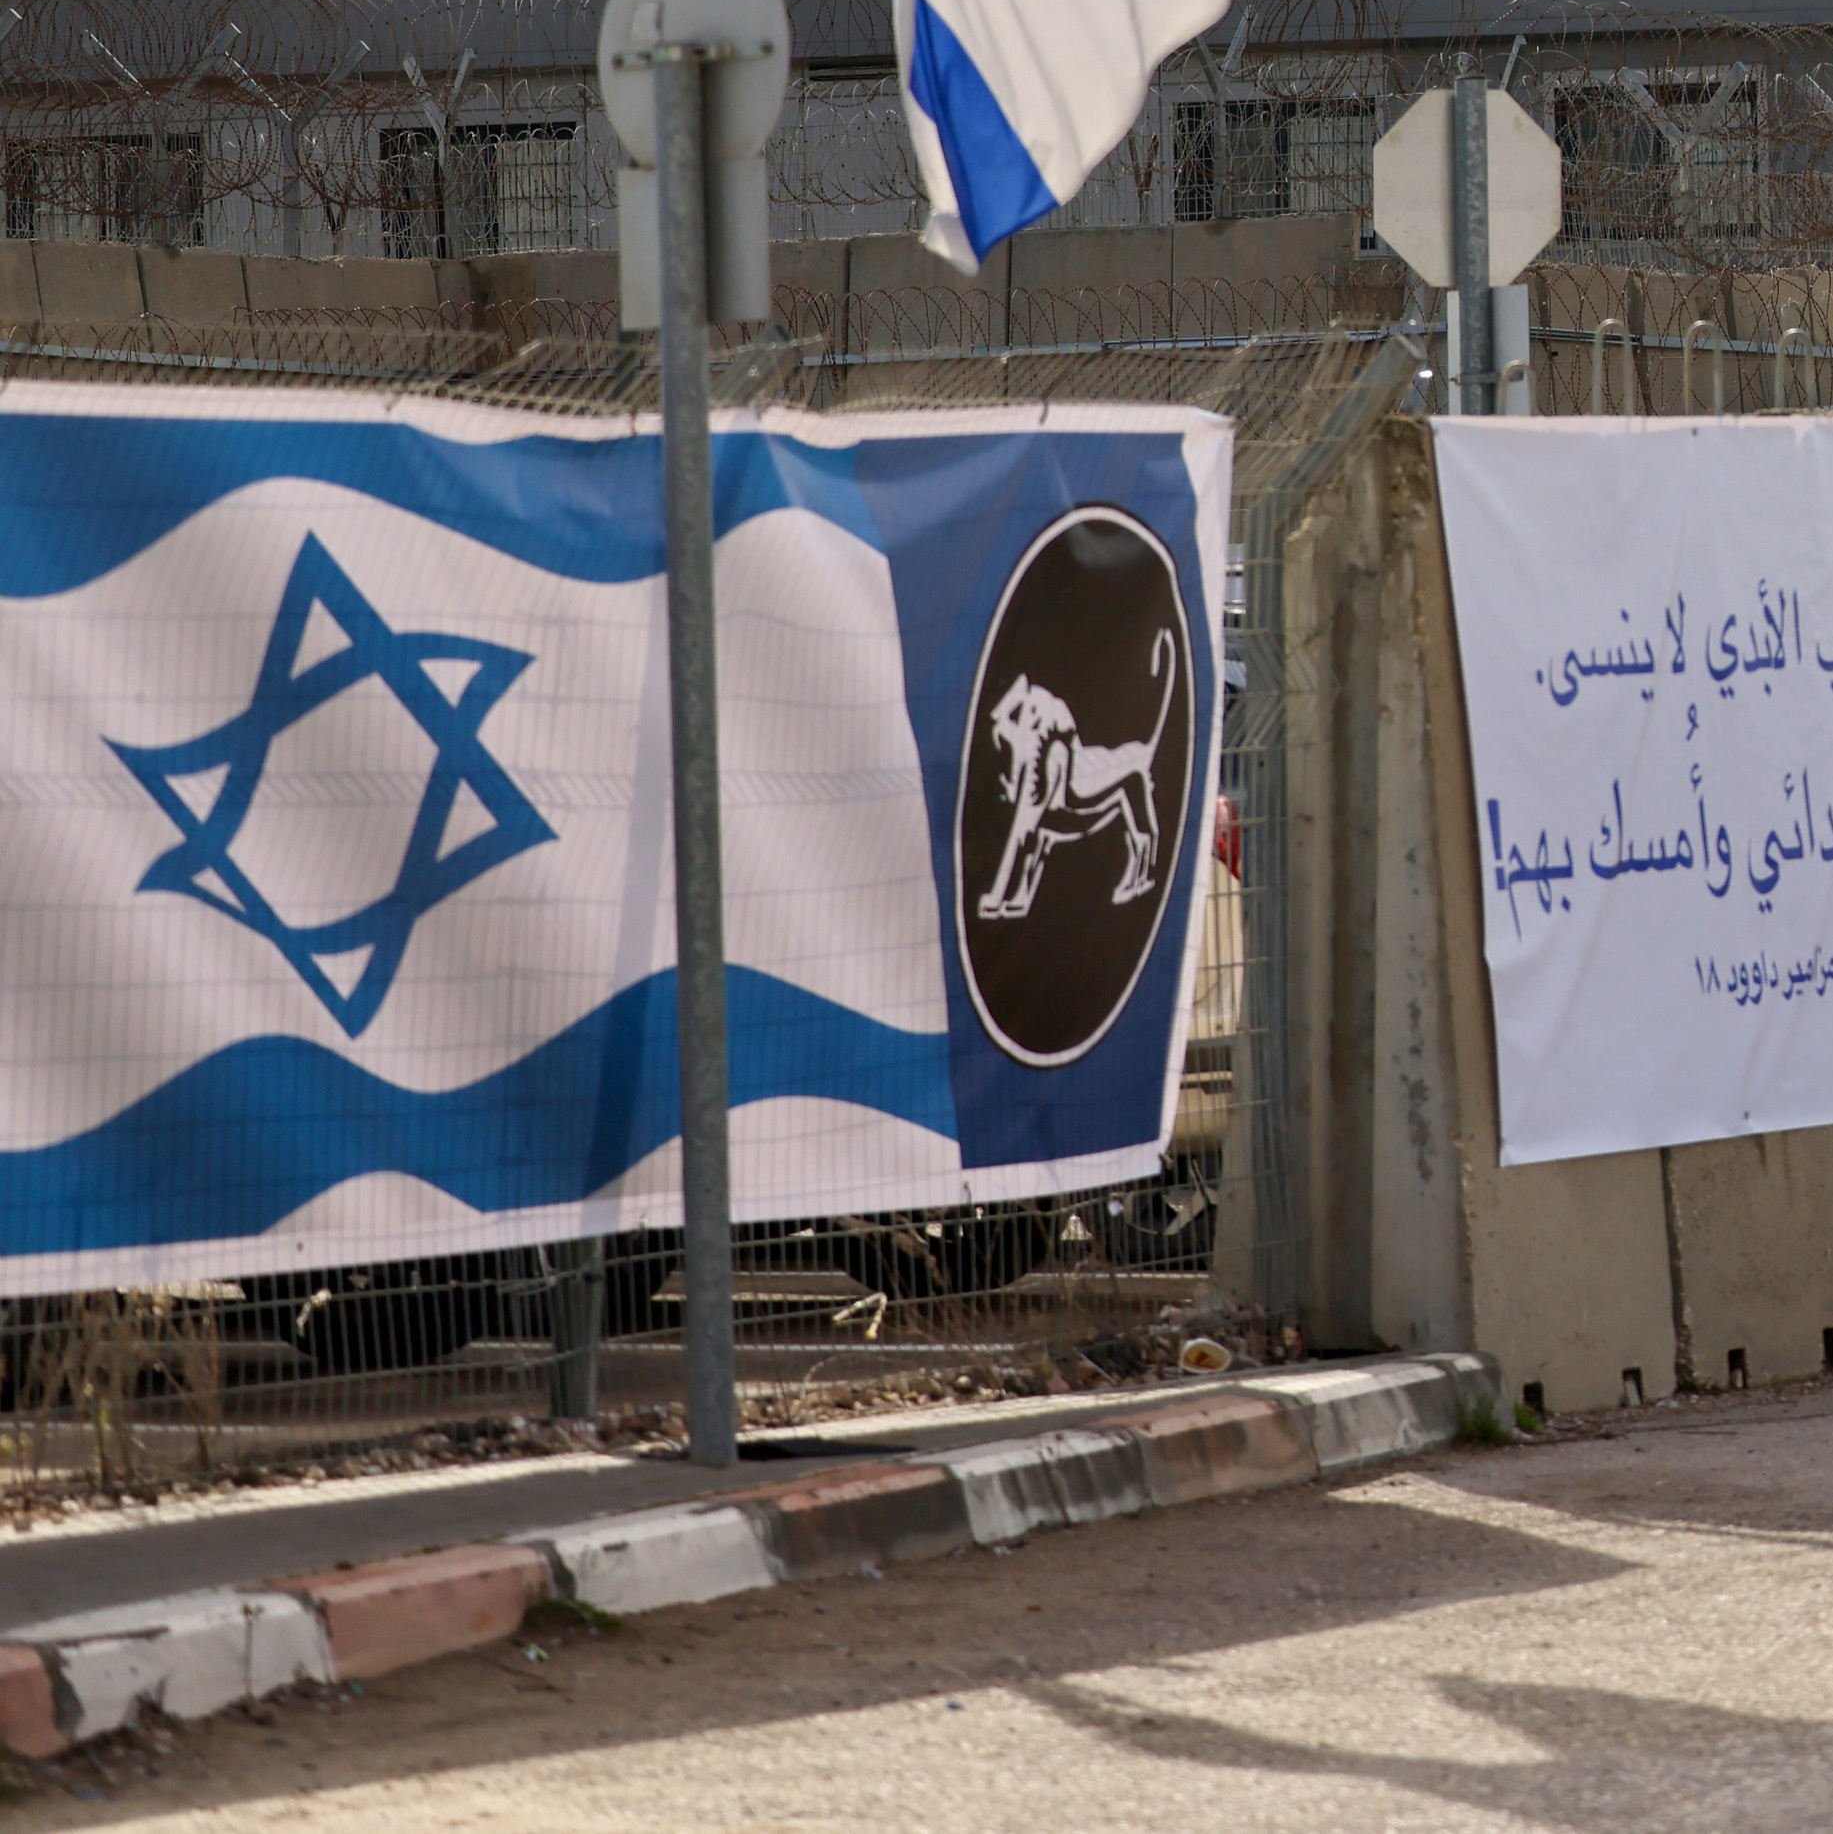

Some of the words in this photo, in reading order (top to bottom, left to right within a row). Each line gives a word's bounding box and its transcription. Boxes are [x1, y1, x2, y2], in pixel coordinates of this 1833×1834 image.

[1536, 609, 1655, 706] ينسى.
[1666, 592, 1688, 674] لا
[1706, 578, 1801, 699] الأبدي
[1487, 798, 1574, 943] بهم!
